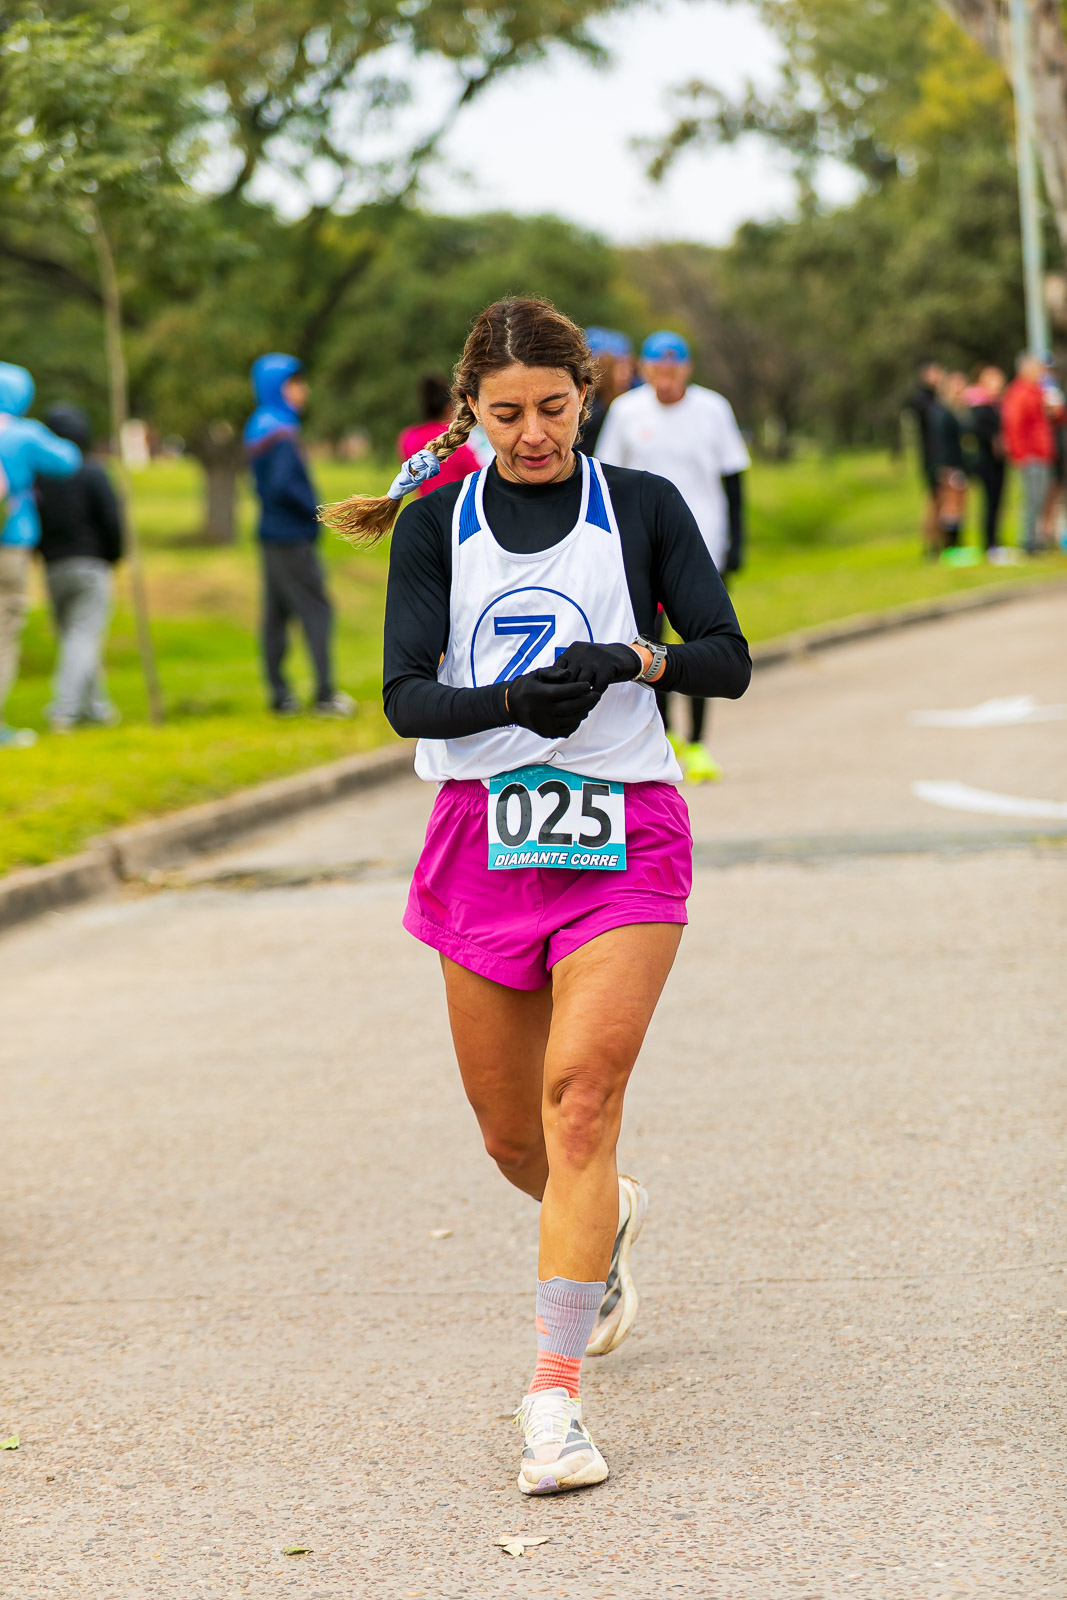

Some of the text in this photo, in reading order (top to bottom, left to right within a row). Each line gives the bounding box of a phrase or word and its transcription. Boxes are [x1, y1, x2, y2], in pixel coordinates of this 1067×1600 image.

[496, 780, 612, 849] 025
[494, 852, 620, 867] DIAMANTE CORRE
